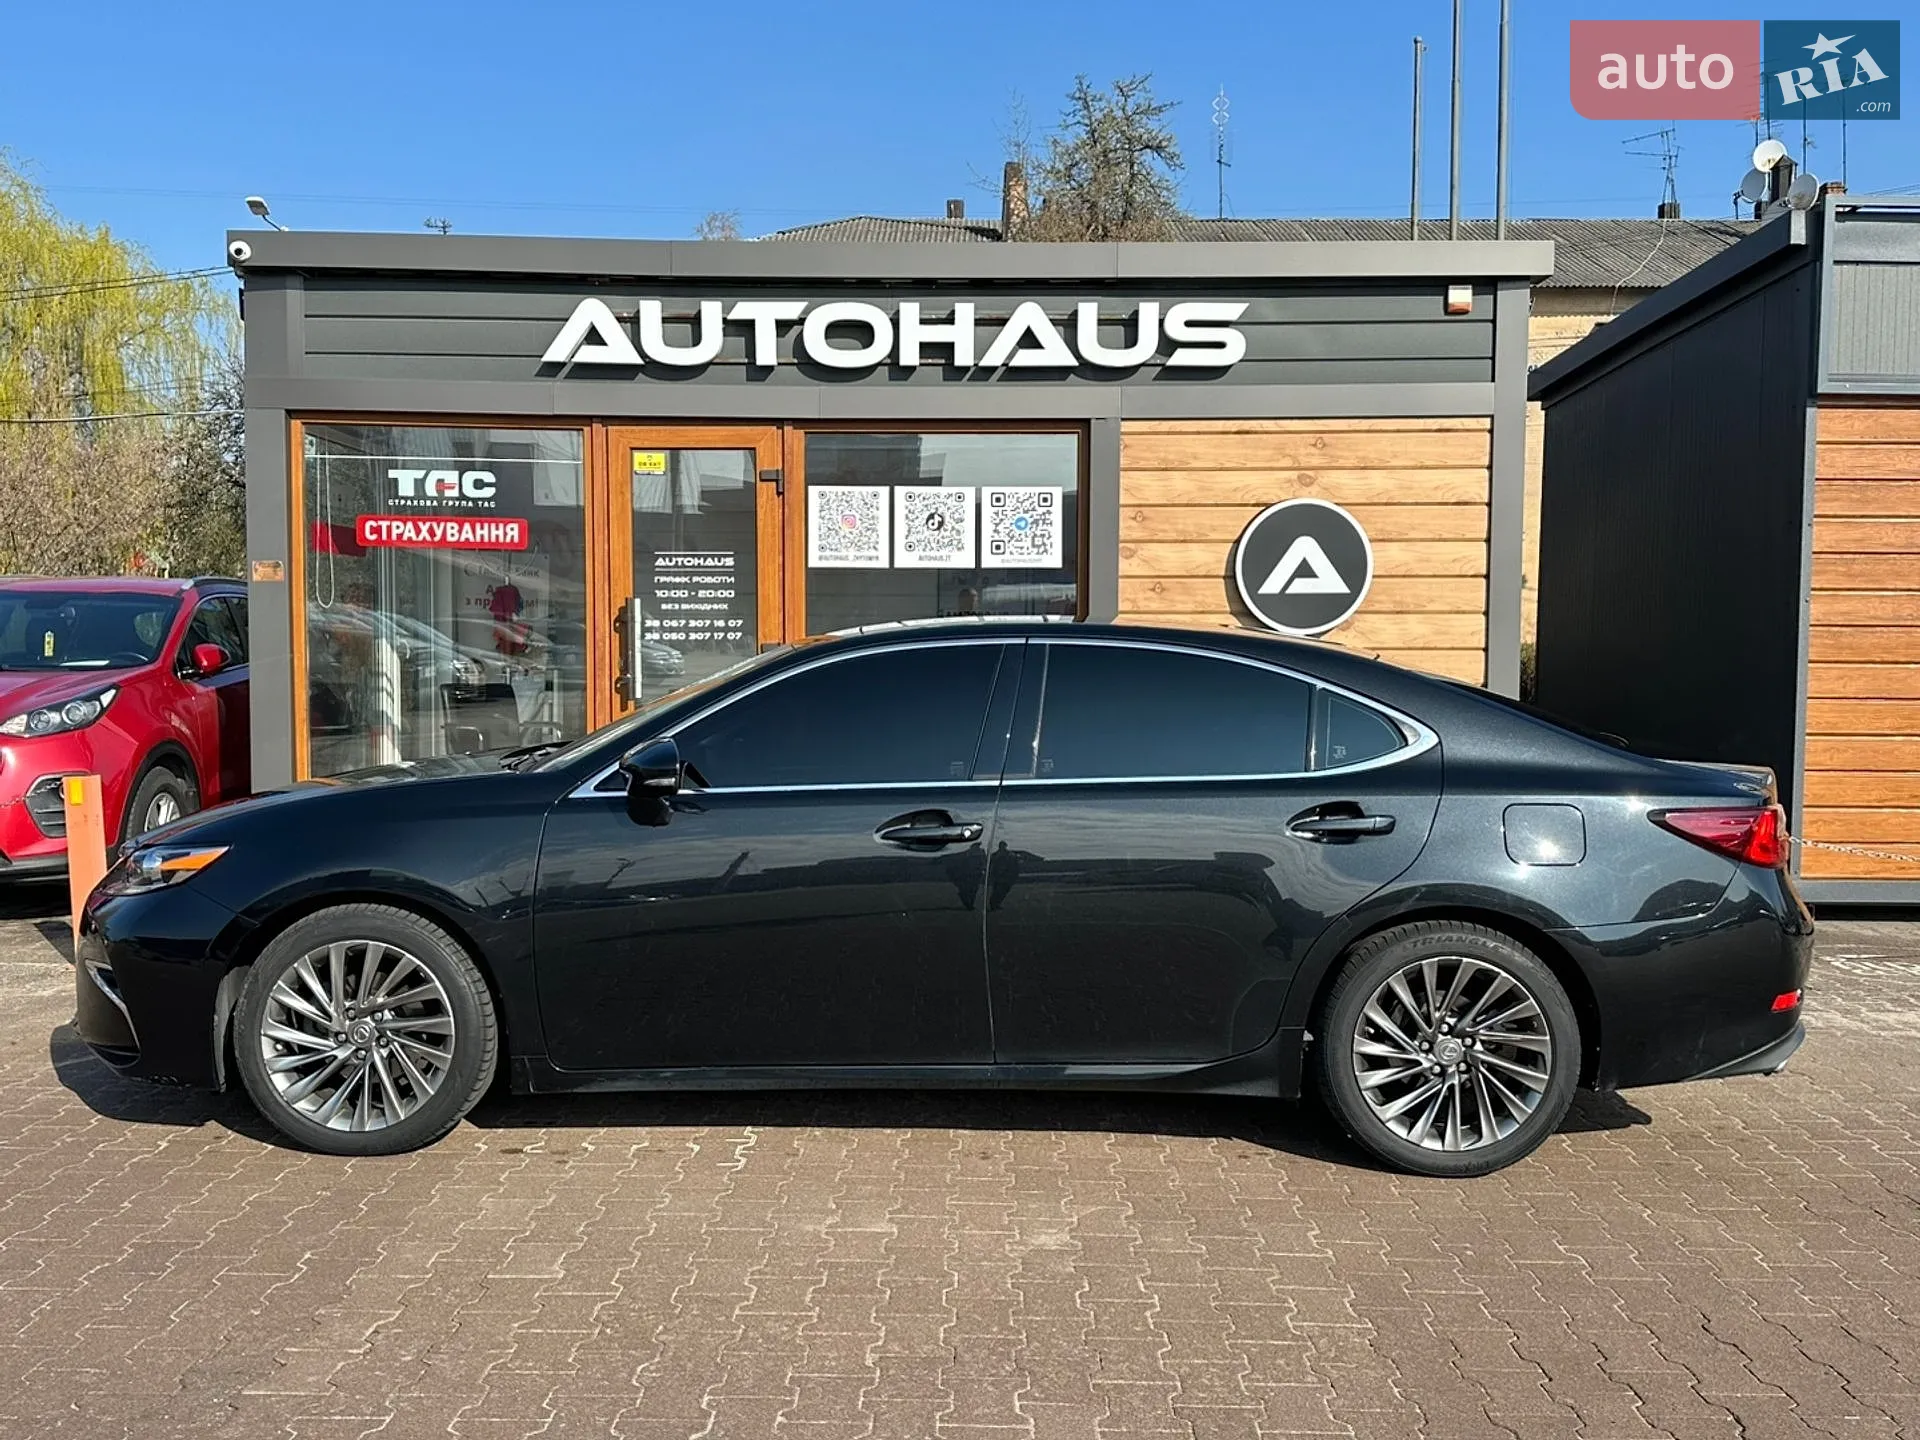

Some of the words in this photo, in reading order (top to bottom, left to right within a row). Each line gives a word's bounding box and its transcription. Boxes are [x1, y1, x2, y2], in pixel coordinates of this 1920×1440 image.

[540, 297, 1250, 369] AUTOHAUS
[388, 469, 496, 498] ТАС
[387, 499, 438, 507] СТРАХОВА
[442, 500, 473, 508] ГРУПА
[364, 520, 519, 543] СТРАХУВАННЯ
[654, 557, 735, 566] AUTOHAUS
[654, 590, 689, 598] 10:00
[697, 590, 735, 598] 20:00
[662, 619, 687, 627] 067
[687, 619, 711, 627] 307
[713, 619, 726, 627] 16
[727, 619, 743, 627] 07
[687, 632, 711, 640] 307
[713, 632, 726, 640] 17
[726, 632, 742, 640] 07
